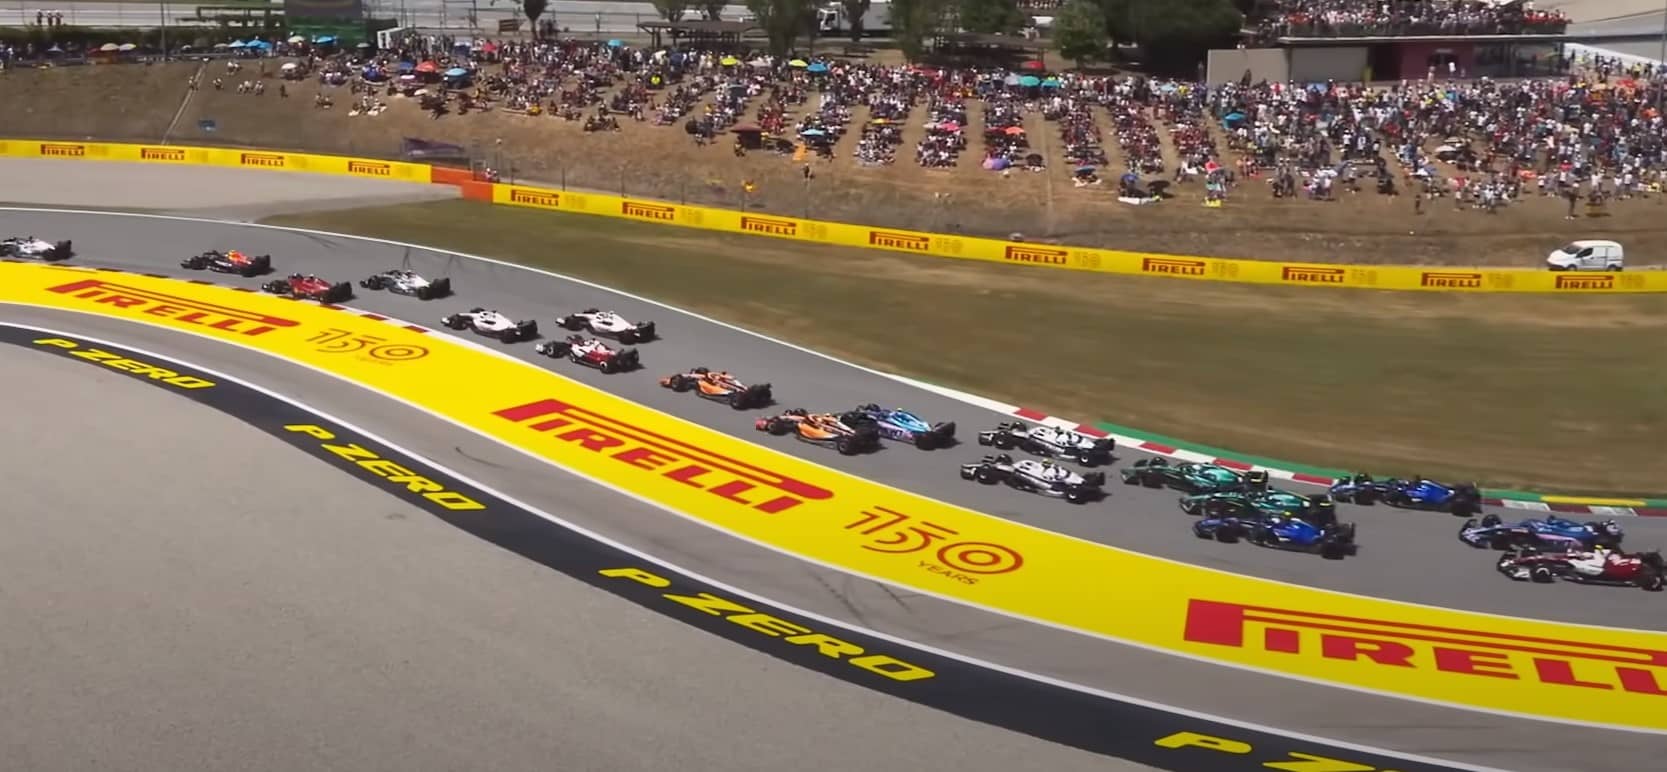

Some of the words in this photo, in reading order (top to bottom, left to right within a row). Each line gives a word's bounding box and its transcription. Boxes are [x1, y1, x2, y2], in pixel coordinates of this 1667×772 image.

[41, 144, 84, 156] PIRELLI
[141, 148, 184, 160] PIRELLI
[241, 153, 284, 166] PIRELLI
[348, 161, 391, 175] PIRELLI
[511, 189, 560, 206] PIRELLI
[622, 201, 676, 220] PIRELLI
[741, 216, 797, 235] PIRELLI
[869, 231, 930, 250] PIRELLI
[1005, 246, 1068, 265] PIRELLI
[1142, 258, 1206, 276] PIRELLI
[1282, 266, 1345, 283] PIRELLI
[1421, 272, 1482, 288] PIRELLI
[1556, 275, 1614, 289] PIRELLI
[46, 279, 301, 336] PIRELLI
[33, 338, 79, 349] P
[70, 349, 216, 389] ZERO
[283, 424, 336, 440] P
[320, 443, 487, 510] ZERO
[494, 398, 834, 514] PIRELLI
[844, 506, 1024, 575] 150
[917, 561, 979, 585] YEARS
[599, 567, 670, 588] P
[663, 592, 935, 681] ZERO
[1183, 598, 1667, 697] PIRELL
[1154, 731, 1252, 754] P
